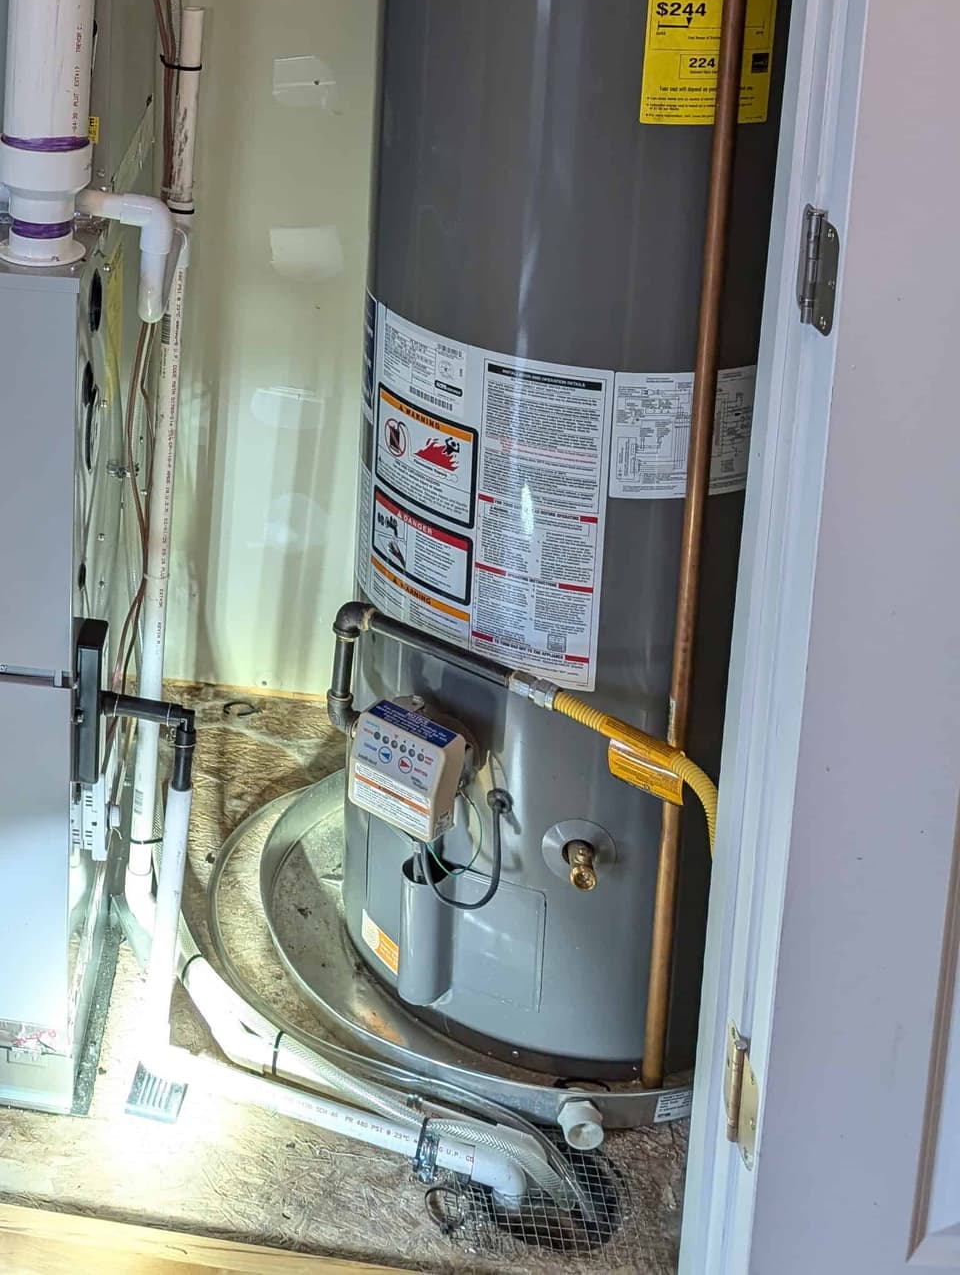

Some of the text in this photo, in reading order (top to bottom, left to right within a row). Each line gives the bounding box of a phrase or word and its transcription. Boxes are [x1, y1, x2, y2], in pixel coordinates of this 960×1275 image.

[656, 1, 707, 17] $244
[688, 57, 716, 68] 224
[405, 407, 441, 429] WARNING
[403, 513, 433, 536] DANGER
[370, 1124, 386, 1135] PSI
